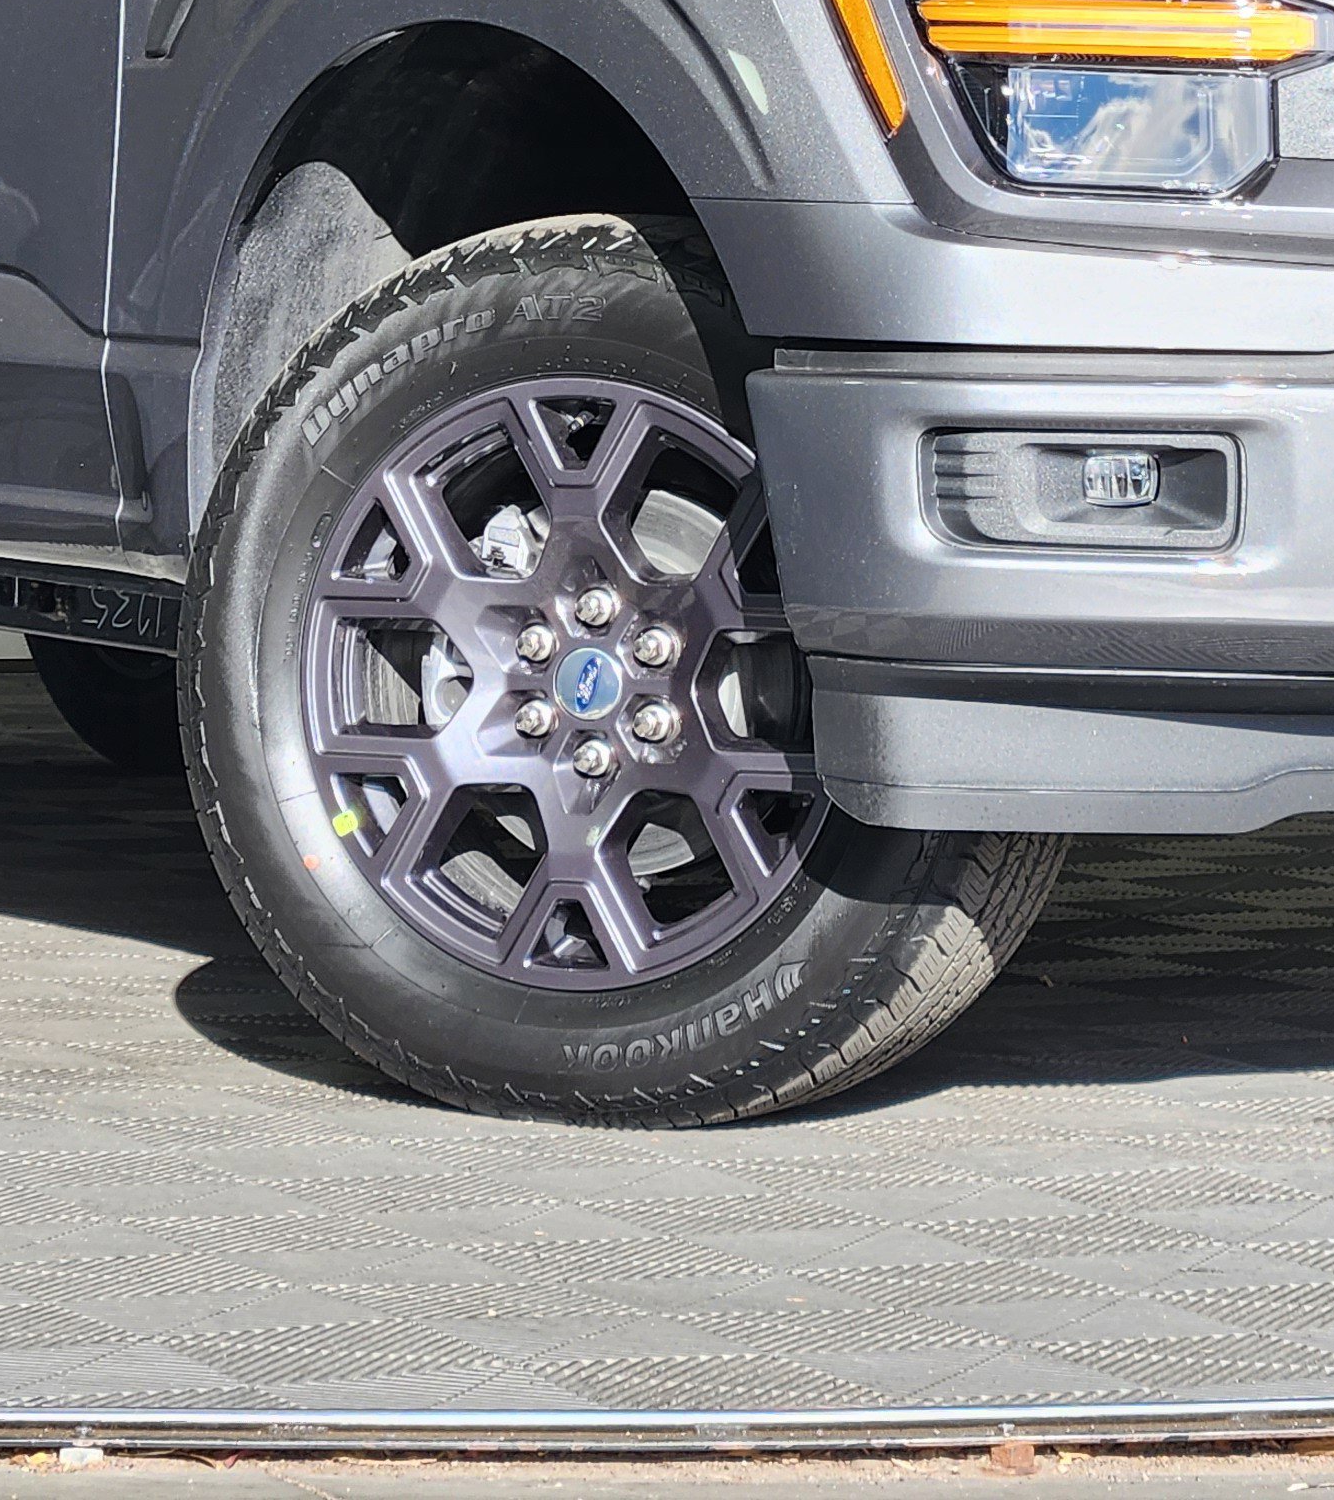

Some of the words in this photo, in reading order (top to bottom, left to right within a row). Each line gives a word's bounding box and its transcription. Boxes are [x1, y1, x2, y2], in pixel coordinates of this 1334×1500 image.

[299, 305, 498, 449] Dynapro
[505, 294, 609, 325] AT2
[576, 663, 600, 705] Ford
